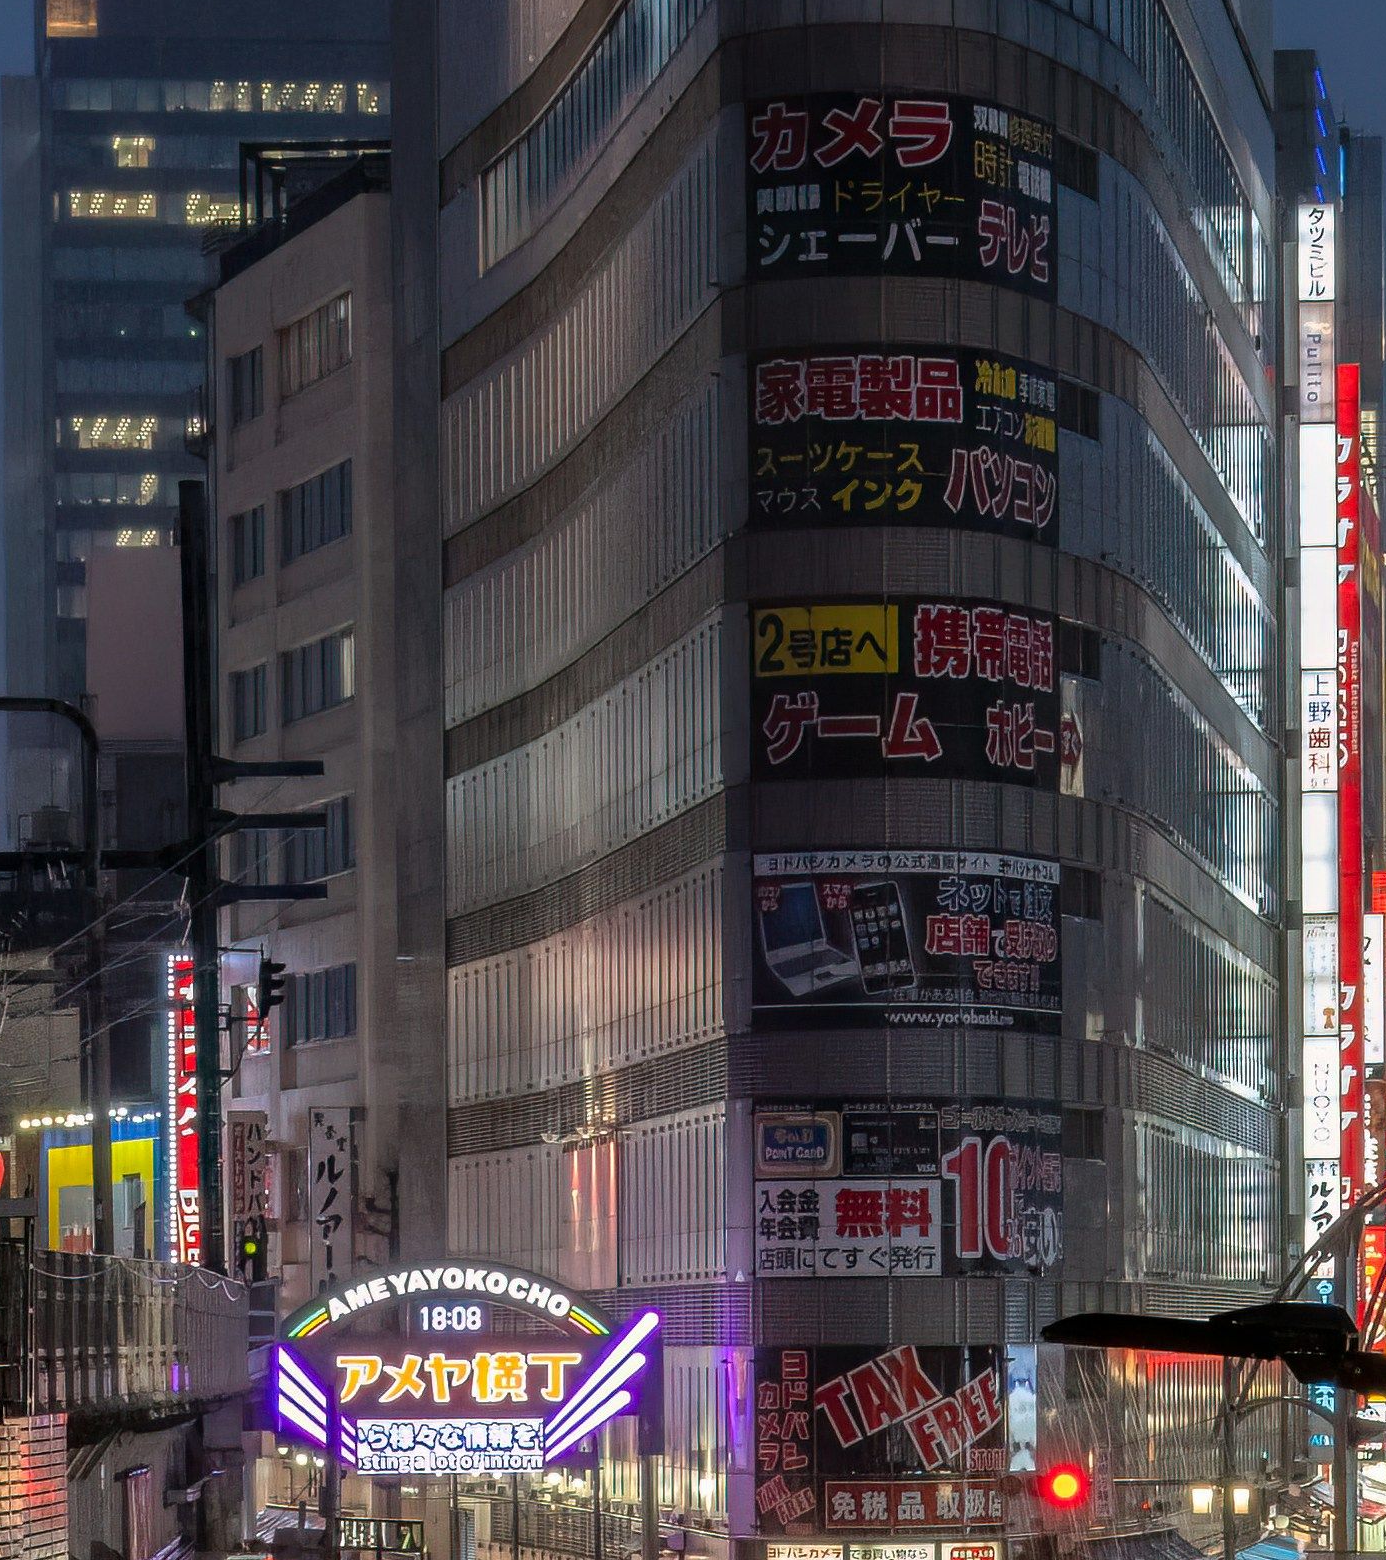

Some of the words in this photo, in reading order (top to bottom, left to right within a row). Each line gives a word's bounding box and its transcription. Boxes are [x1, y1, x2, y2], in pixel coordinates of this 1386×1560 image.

[750, 98, 953, 173] カメラ
[974, 140, 1013, 187] 時計
[835, 180, 965, 213] ドライヤー
[759, 218, 959, 265] シェーバー
[978, 199, 1049, 282] テレビ
[1309, 208, 1327, 297] タツミビル
[756, 355, 963, 425] 家電製品
[976, 406, 1024, 439] エアコン
[757, 441, 924, 475] スーツケース
[757, 488, 821, 513] マウス
[832, 479, 922, 512] インク
[944, 445, 1056, 528] パソコン
[759, 614, 887, 672] 2号店へ
[914, 604, 1053, 692] 携帯電話
[763, 691, 943, 765] ゲーム
[985, 699, 1054, 770] ホビー
[1308, 674, 1331, 774] 上野歯科
[827, 896, 848, 909] から
[1313, 1063, 1331, 1142] NUOVO
[765, 1147, 793, 1160] POINT
[795, 1146, 825, 1159] CARD
[917, 1164, 936, 1173] VISA
[760, 1189, 820, 1213] 入会金
[835, 1188, 933, 1238] 無料
[760, 1216, 820, 1240] 年会費
[760, 1246, 936, 1271] 店頭にてすぐ発行
[328, 1267, 571, 1322] AMEYAYOKOCHO
[420, 1306, 482, 1331] 18:08
[336, 1352, 583, 1404] アメヤ横丁
[815, 1345, 943, 1448] TAX
[759, 1382, 780, 1470] カメラ
[782, 1351, 809, 1470] ヨドバシ
[904, 1367, 1004, 1471] FREE
[414, 1456, 427, 1469] a
[430, 1452, 456, 1469] lot
[461, 1452, 480, 1470] of
[756, 1474, 790, 1514] TAX
[832, 1491, 1003, 1520] 免税品取扱店
[768, 1547, 842, 1559] ヨドバシカメラ
[850, 1548, 928, 1560] でお買い物なら
